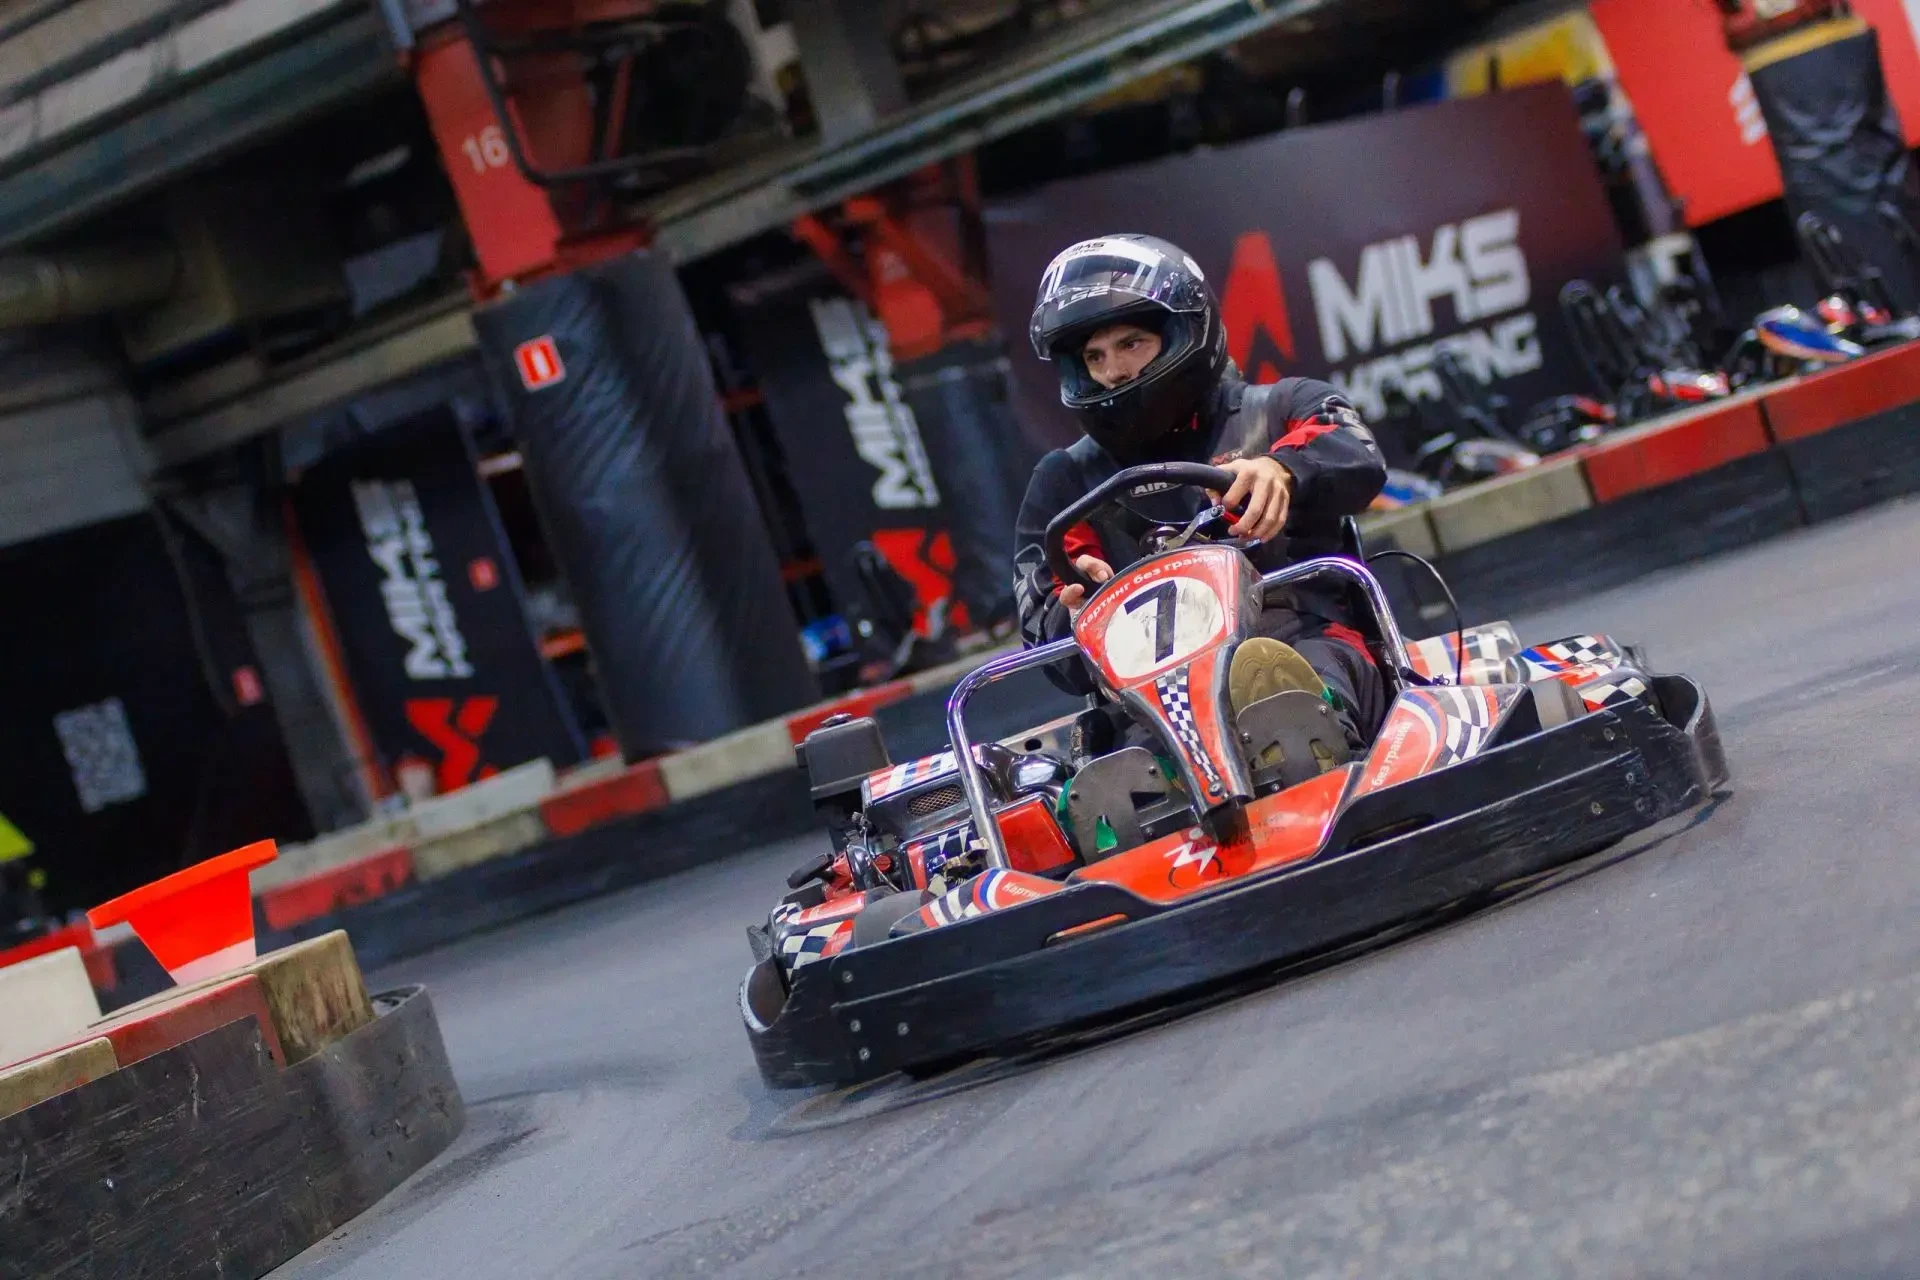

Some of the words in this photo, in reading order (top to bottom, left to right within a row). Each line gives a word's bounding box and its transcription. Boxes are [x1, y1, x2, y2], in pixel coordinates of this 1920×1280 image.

[462, 125, 509, 176] 16
[1057, 286, 1111, 311] LS2
[1308, 208, 1531, 363] MIKS
[1079, 582, 1131, 633] Картинг
[1133, 566, 1162, 585] без
[1123, 580, 1178, 664] 7
